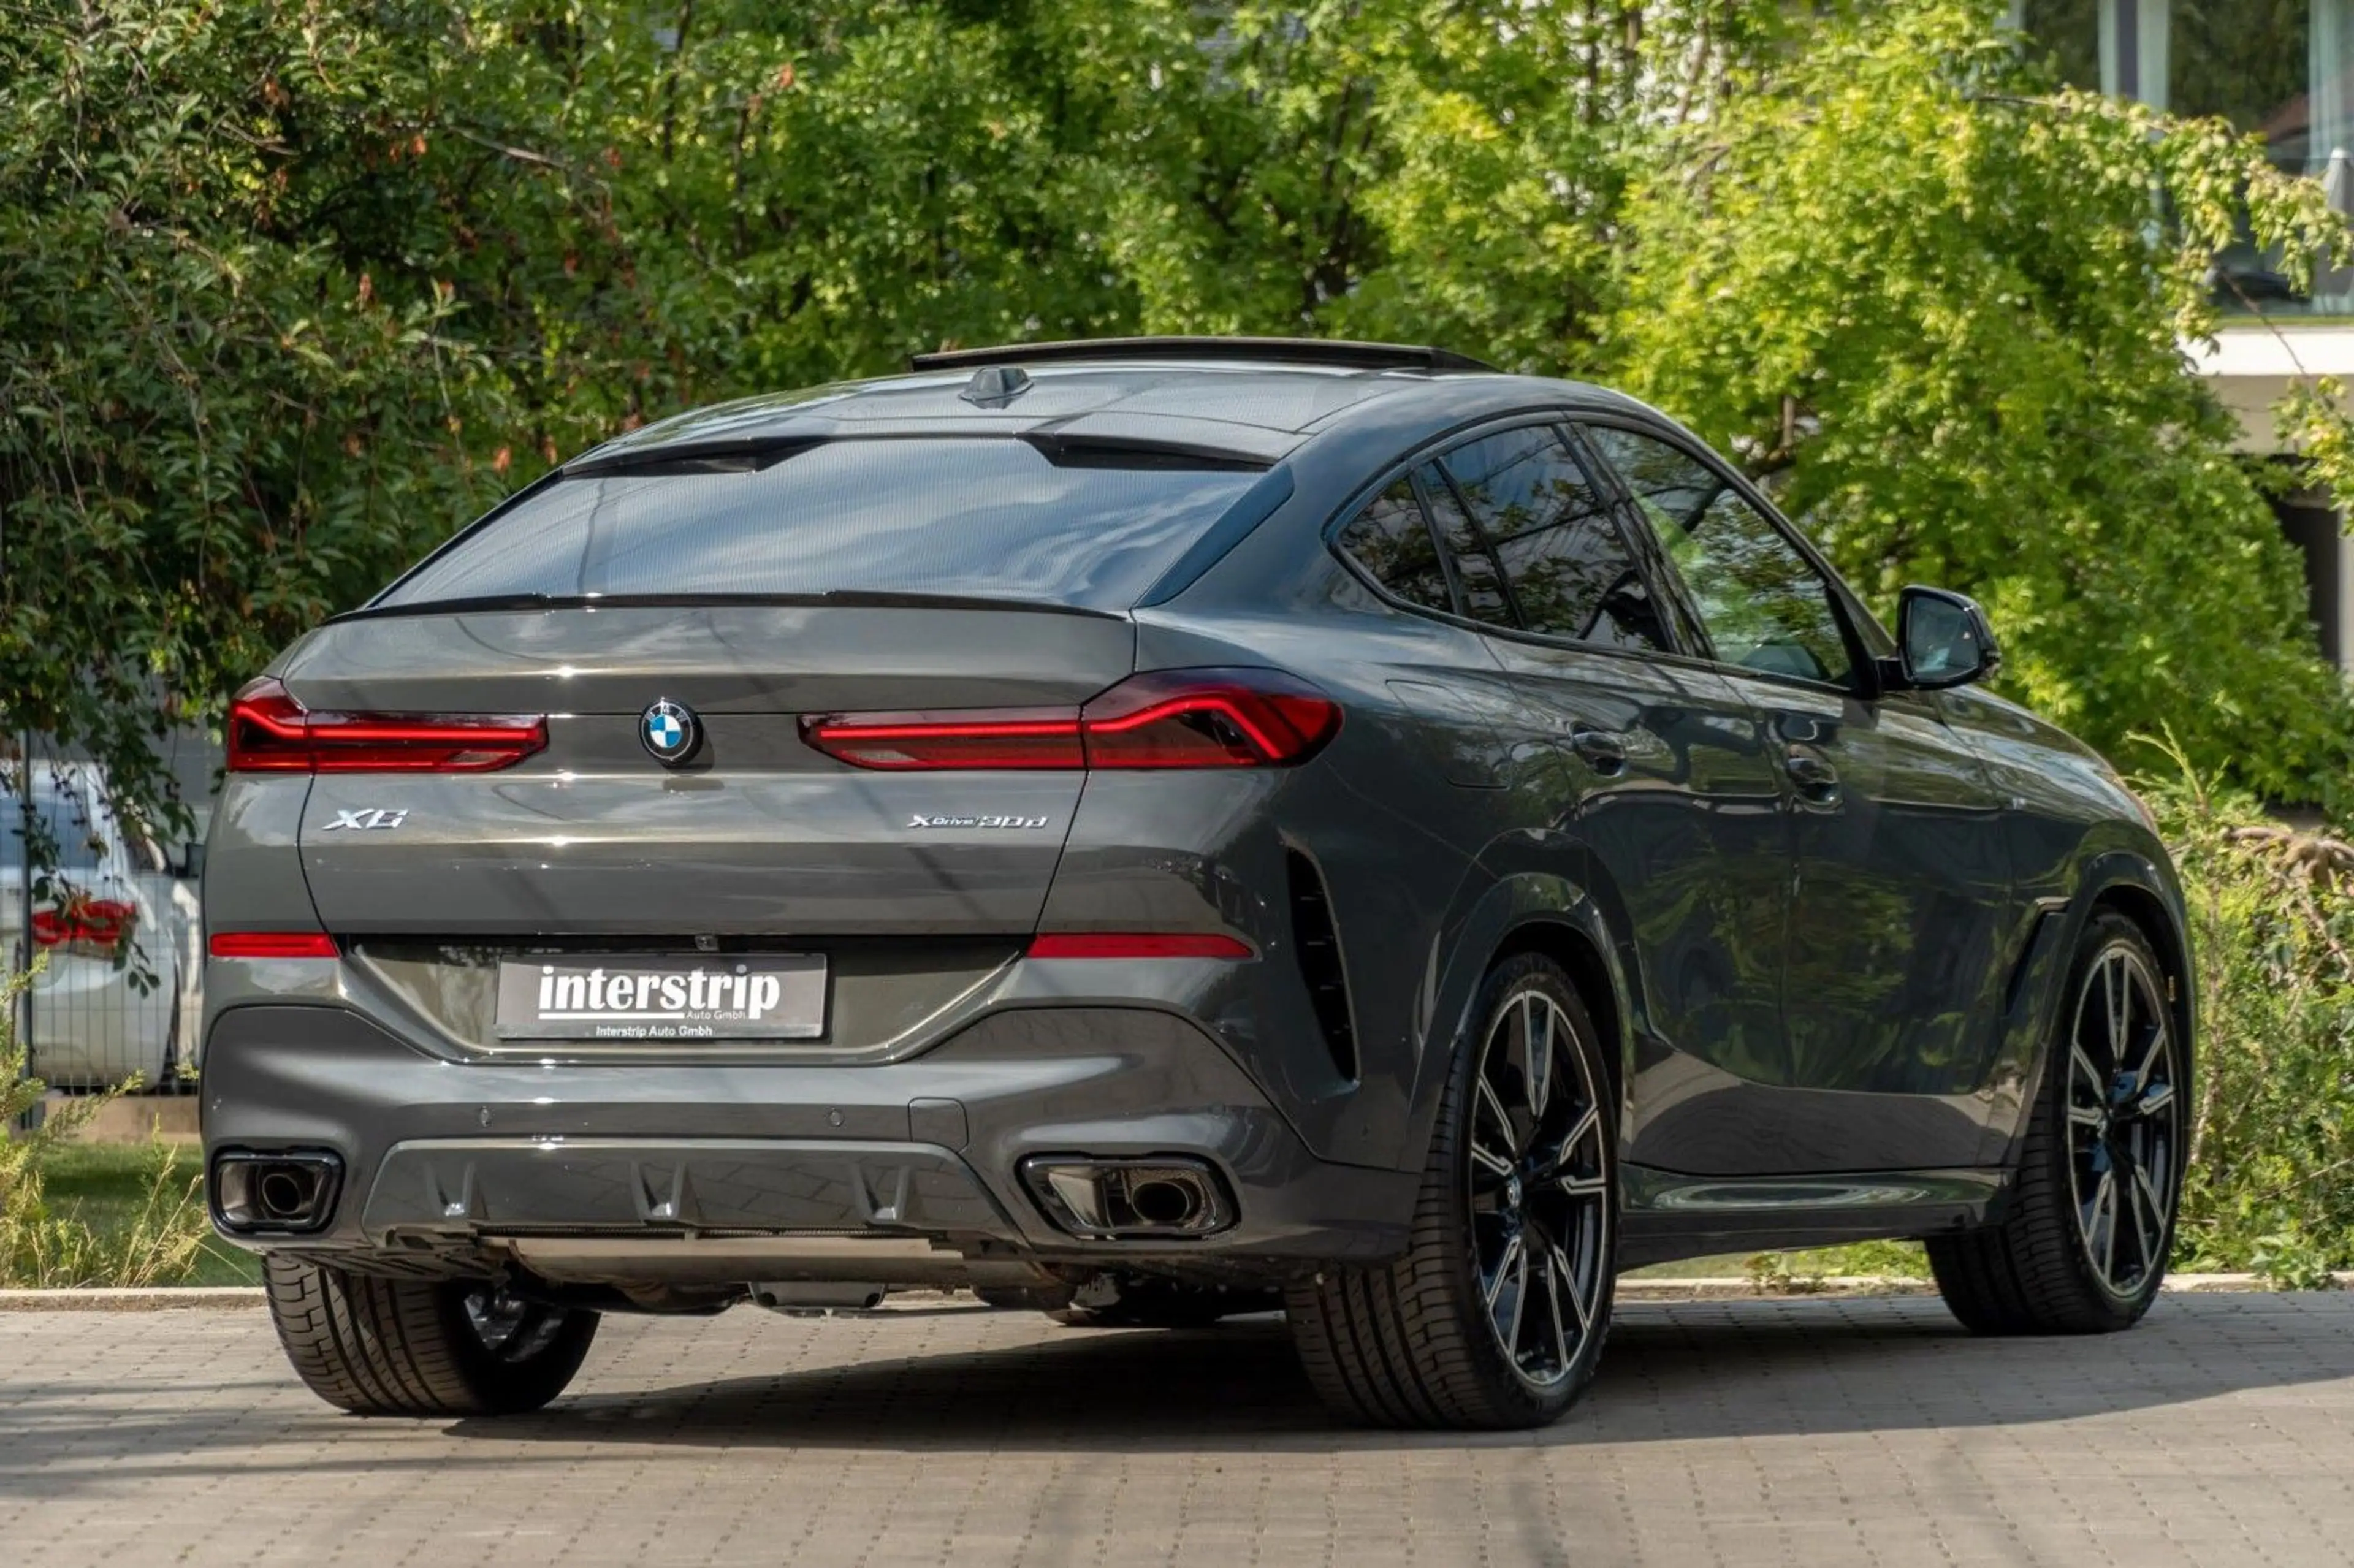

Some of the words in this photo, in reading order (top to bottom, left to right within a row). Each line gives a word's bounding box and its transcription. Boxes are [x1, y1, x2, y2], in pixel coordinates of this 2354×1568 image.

[322, 808, 409, 829] X6
[538, 965, 780, 1020] interstrip
[686, 1010, 711, 1020] Auto
[596, 1026, 647, 1038] Interstrip
[649, 1026, 674, 1037] Auto
[678, 1025, 712, 1037] Gmbh
